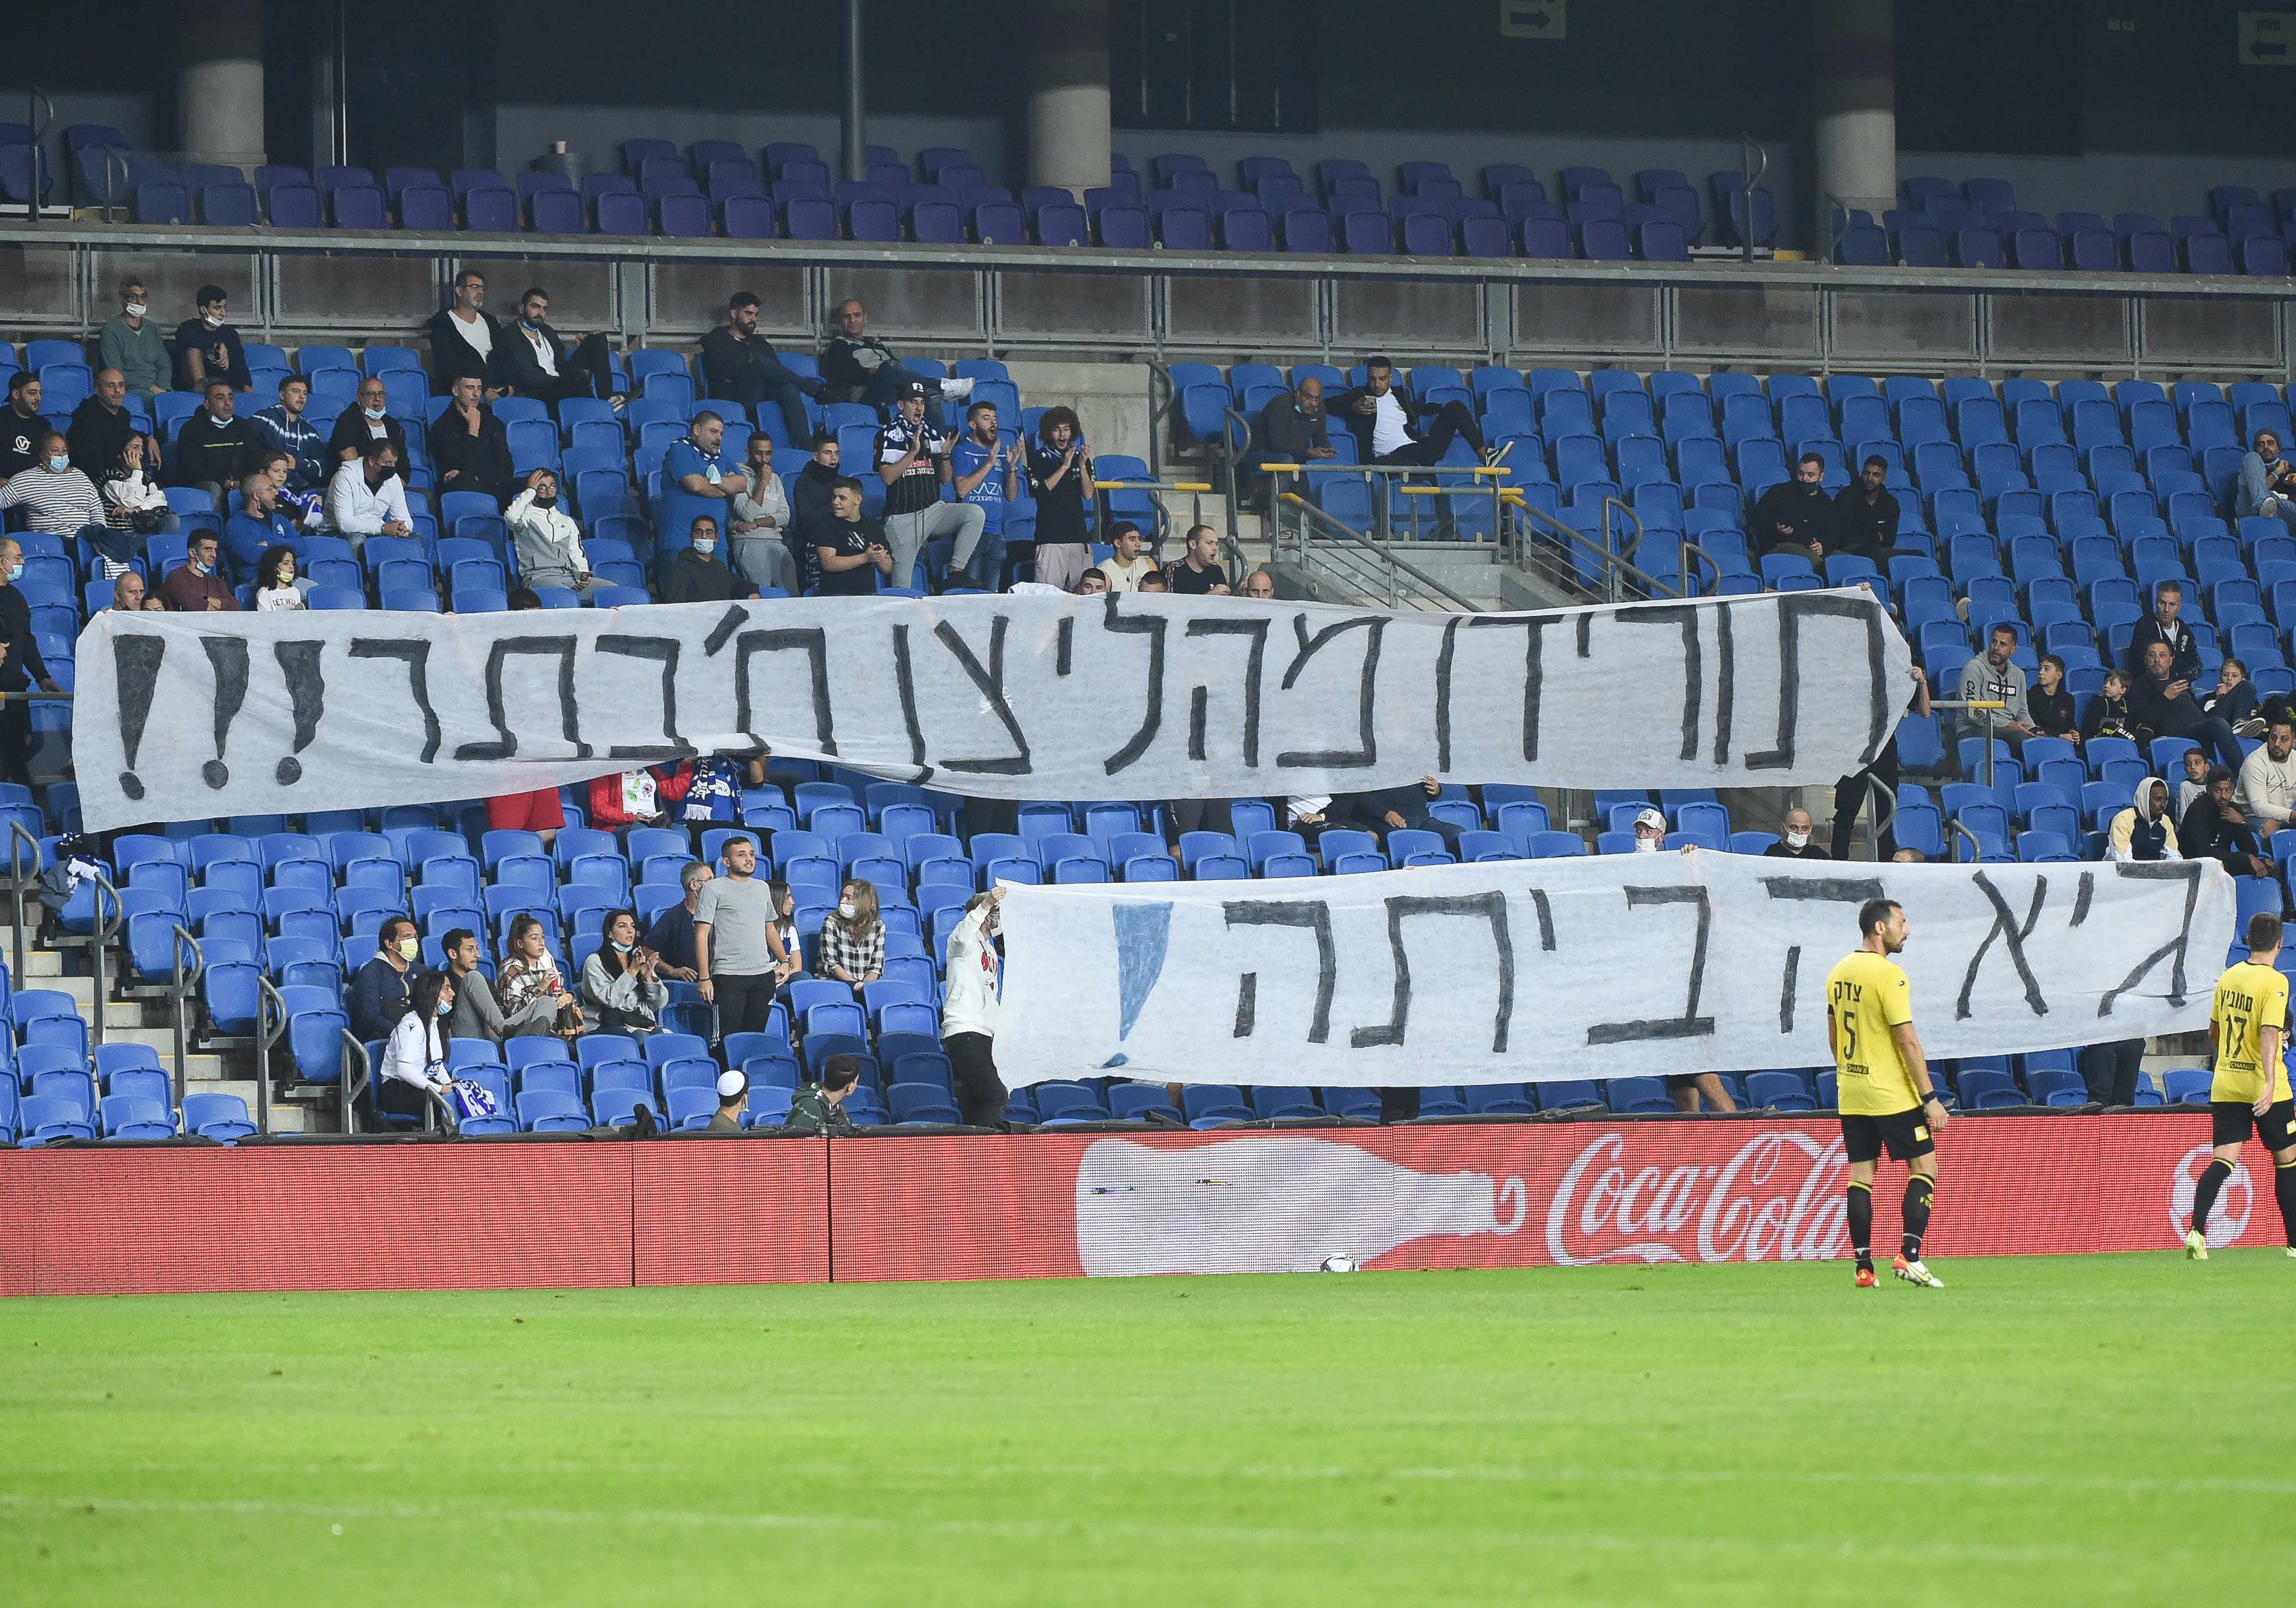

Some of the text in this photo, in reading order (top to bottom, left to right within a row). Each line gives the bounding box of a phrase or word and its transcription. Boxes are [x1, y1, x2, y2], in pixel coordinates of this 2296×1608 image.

[1834, 980, 1862, 1005] צדק
[1843, 1011, 1856, 1060] 5
[2225, 1014, 2248, 1059] 17
[1546, 1132, 1849, 1266] Coca-Cola
